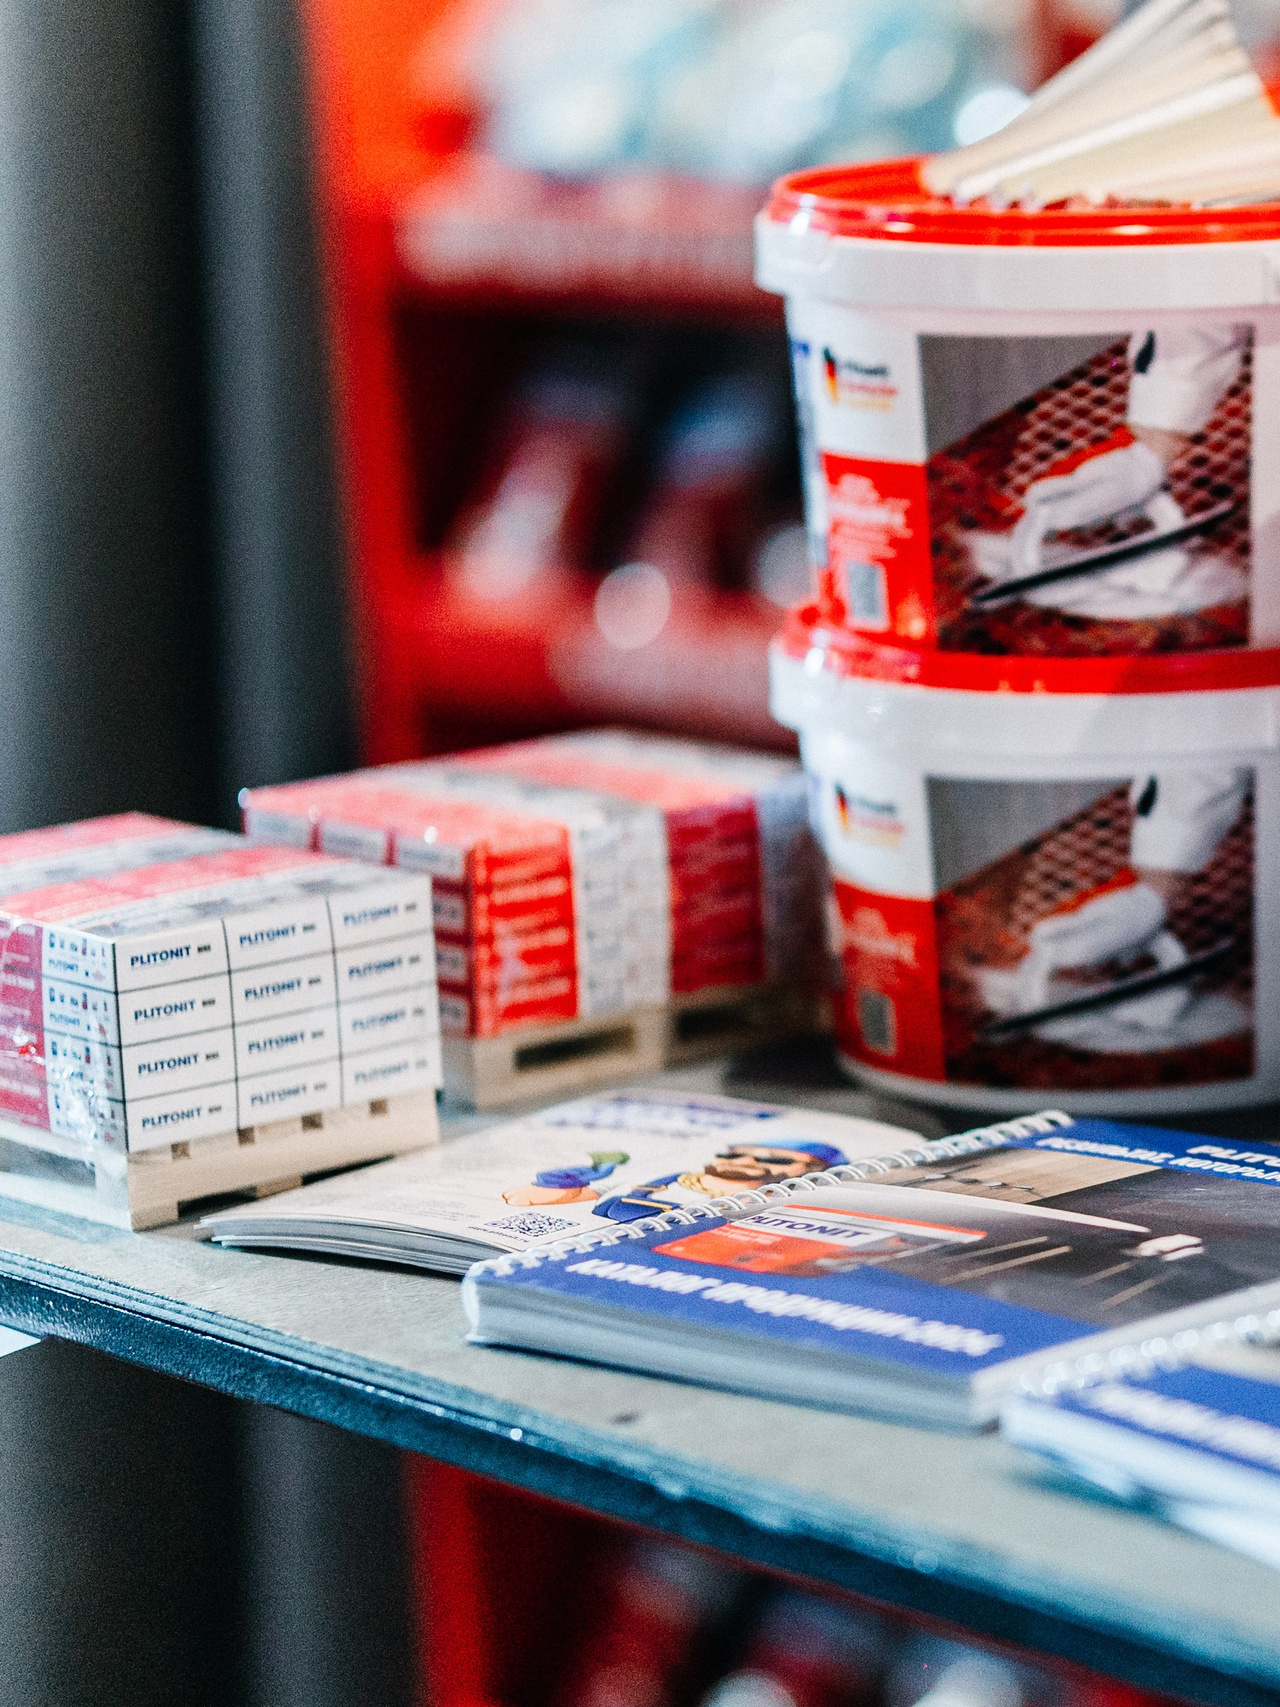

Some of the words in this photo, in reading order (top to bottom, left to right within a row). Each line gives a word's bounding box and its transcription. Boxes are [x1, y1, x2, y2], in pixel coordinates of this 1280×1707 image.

[130, 945, 191, 966] PLITONIT
[134, 999, 196, 1020] PLITONIT
[138, 1053, 199, 1074] PLITONIT
[142, 1107, 202, 1128] PLITONIT
